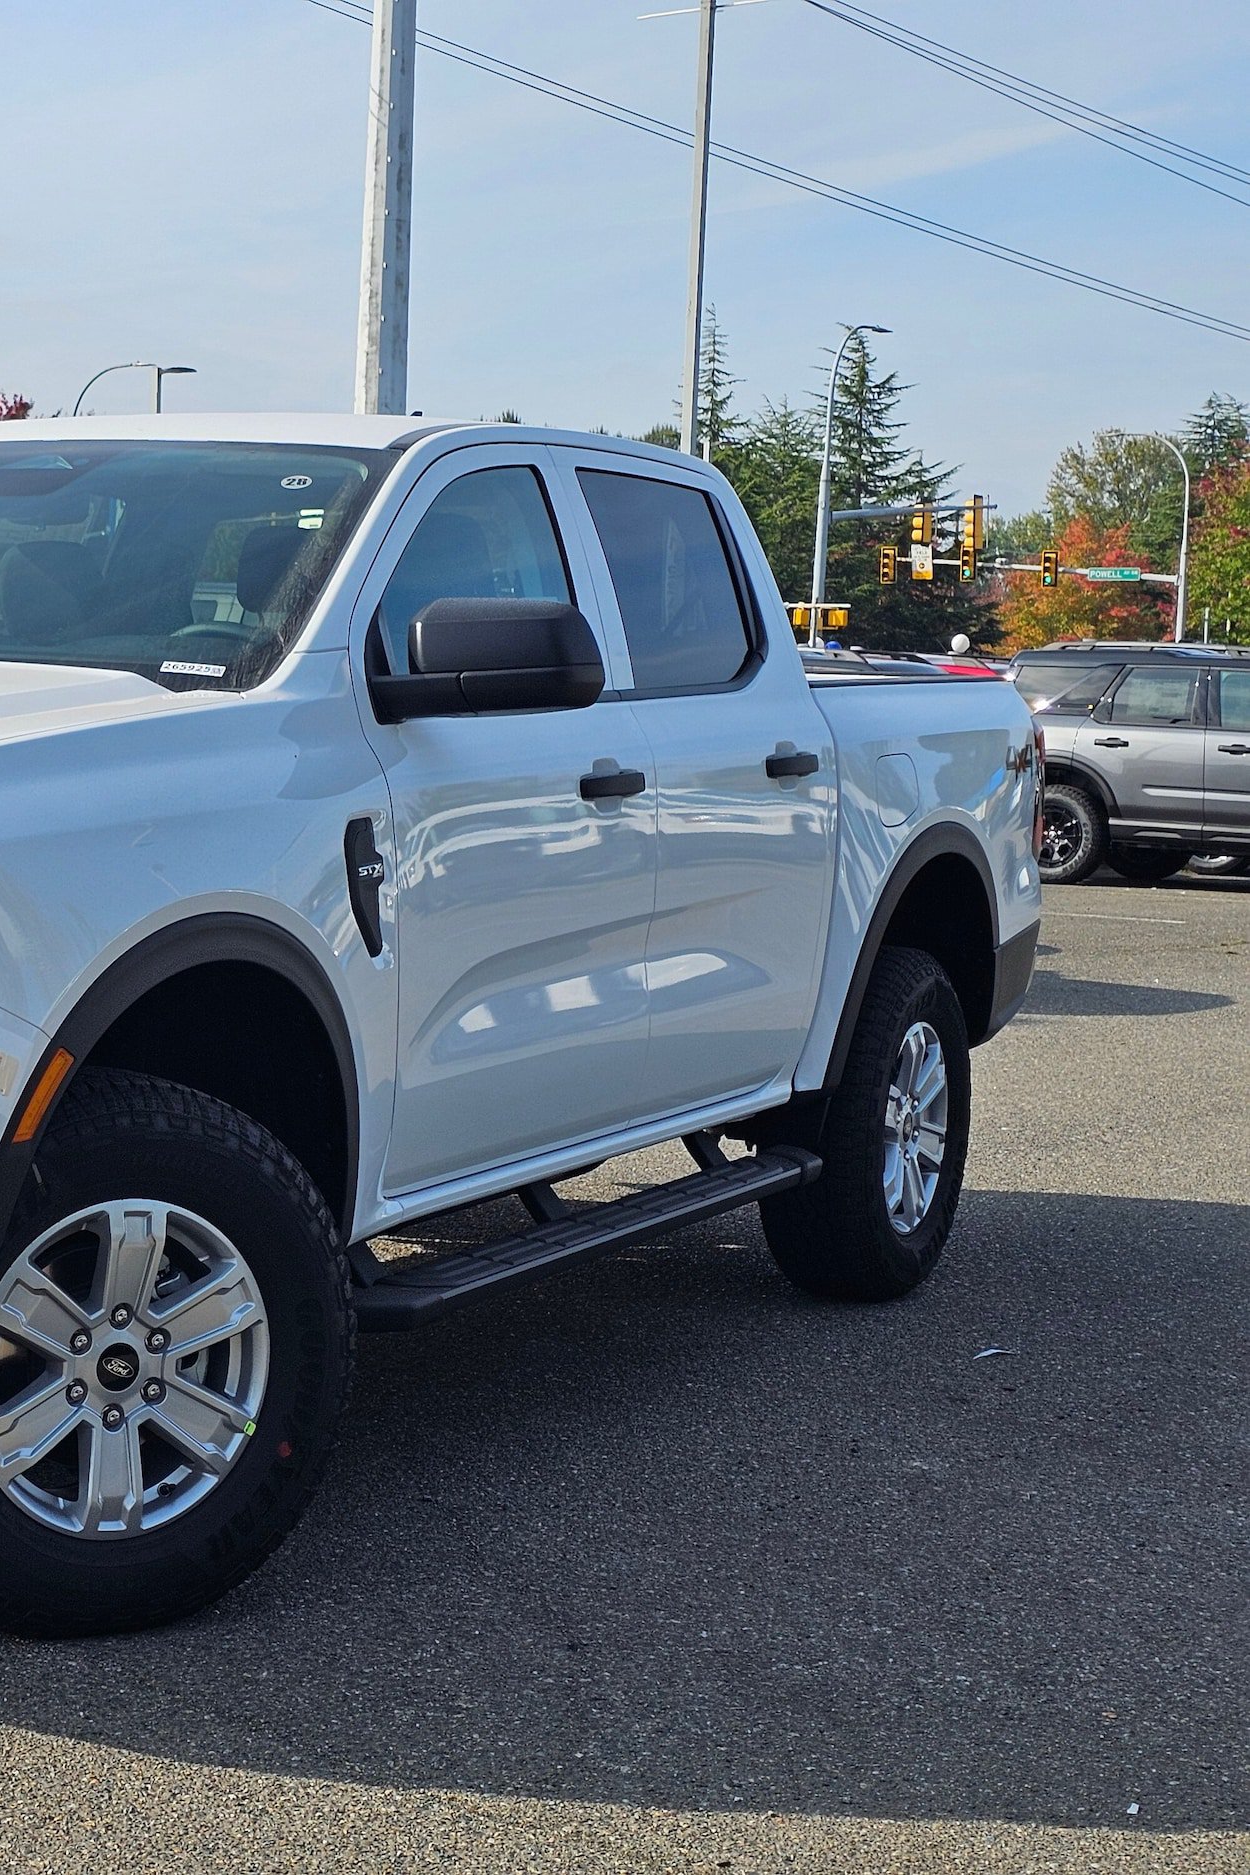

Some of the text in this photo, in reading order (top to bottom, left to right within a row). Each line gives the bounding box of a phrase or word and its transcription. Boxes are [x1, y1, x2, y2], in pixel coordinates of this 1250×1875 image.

[285, 478, 308, 486] 28
[1090, 571, 1123, 579] POWELL
[163, 663, 211, 674] 265925
[107, 1359, 130, 1376] Ford
